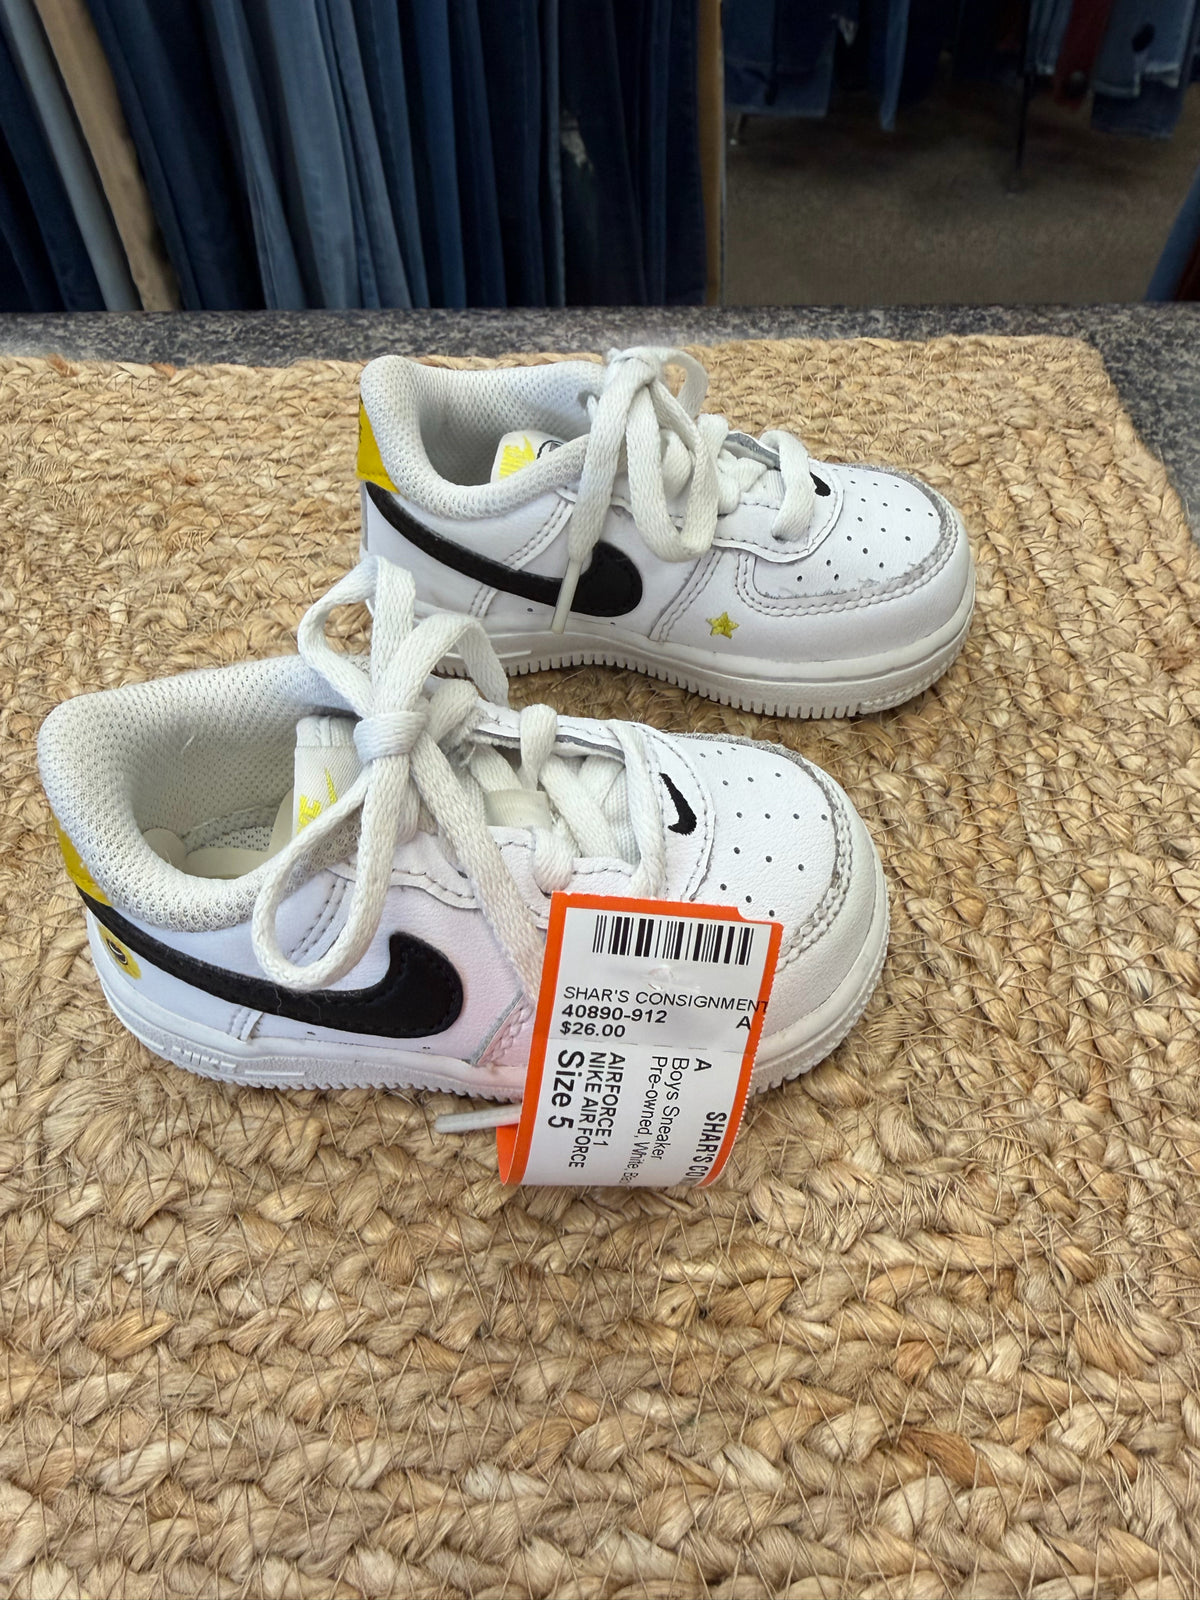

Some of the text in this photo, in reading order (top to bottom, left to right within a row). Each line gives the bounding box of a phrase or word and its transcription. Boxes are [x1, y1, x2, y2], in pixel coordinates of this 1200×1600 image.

[561, 1004, 668, 1024] 40890-912
[563, 986, 768, 1013] SHAR'S CONSIGNMENT
[560, 1020, 626, 1038] $26.00
[736, 1016, 751, 1030] A
[694, 1058, 712, 1072] A
[547, 1050, 585, 1129] Size 5
[595, 1052, 626, 1138] AIRFORCE
[651, 1057, 690, 1160] Boys Sneaker
[568, 1051, 606, 1168] NIKE AIR FORCE
[692, 1111, 727, 1163] SHAR'S
